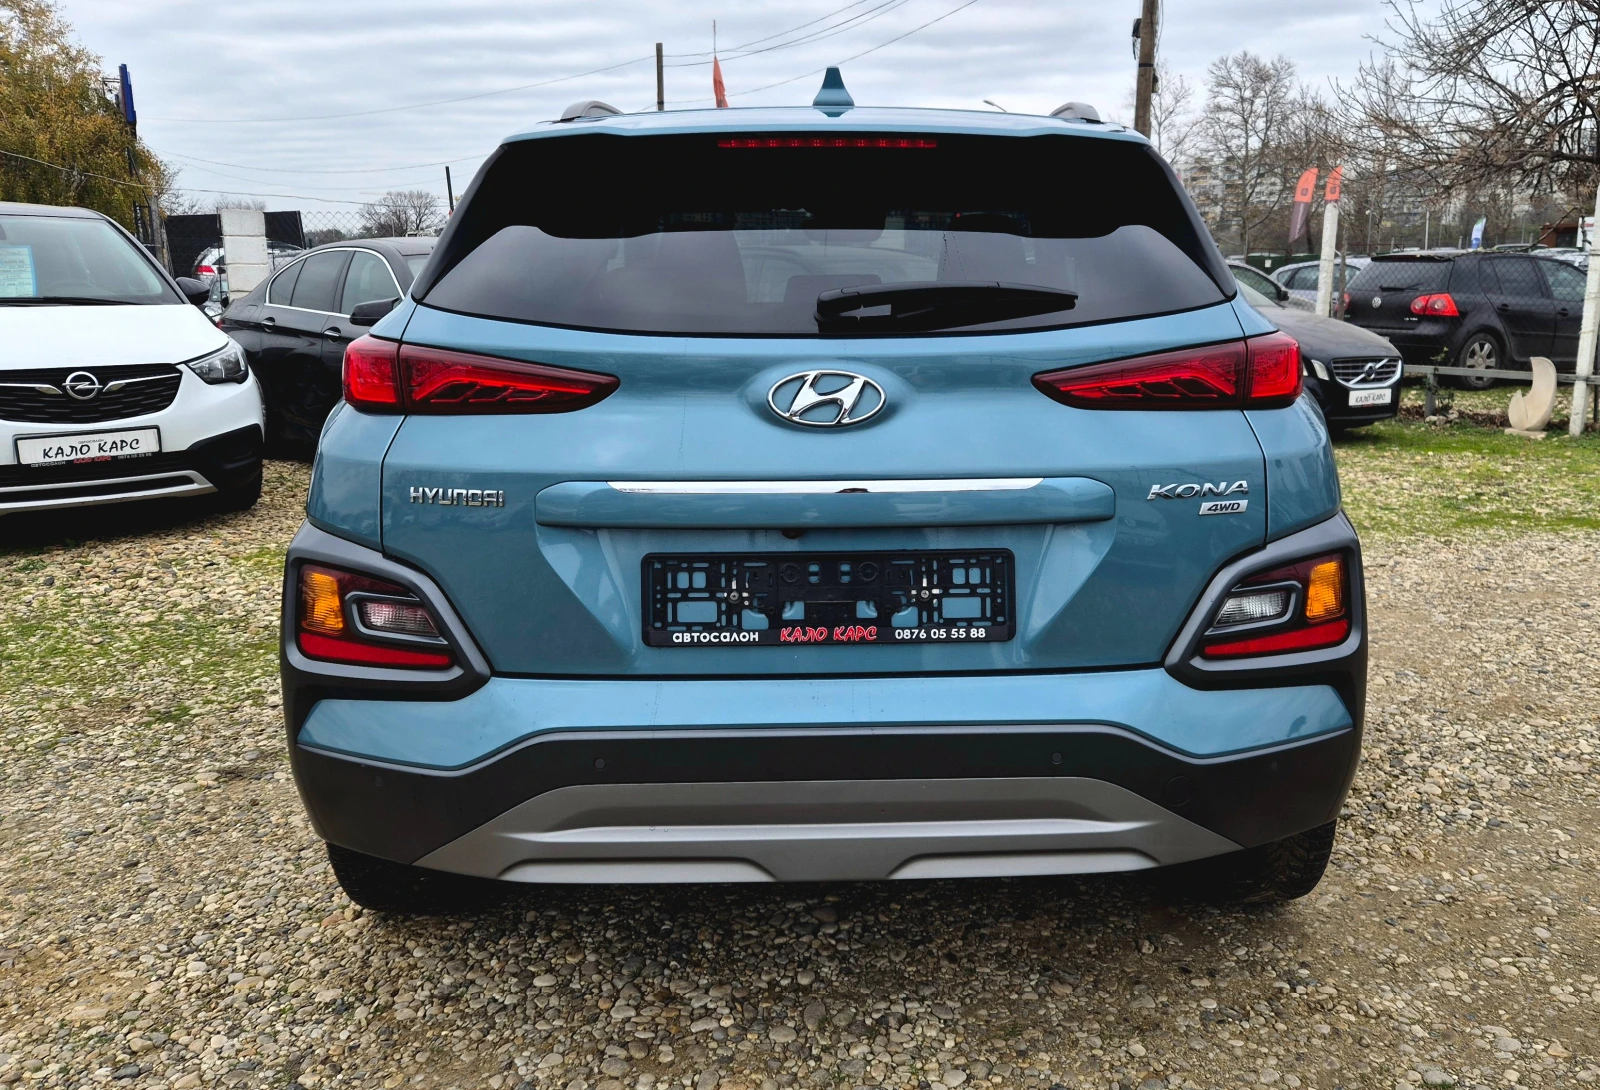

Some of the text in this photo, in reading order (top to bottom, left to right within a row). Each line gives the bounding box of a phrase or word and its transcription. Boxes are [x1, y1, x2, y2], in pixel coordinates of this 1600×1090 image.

[43, 438, 140, 459] КАЛО КАРС
[410, 486, 504, 507] HYUNDAI
[1146, 480, 1249, 500] KONA
[1207, 502, 1241, 512] 4WD
[672, 625, 986, 643] автосалон КАЛО КАРС 0876 05 55 88
